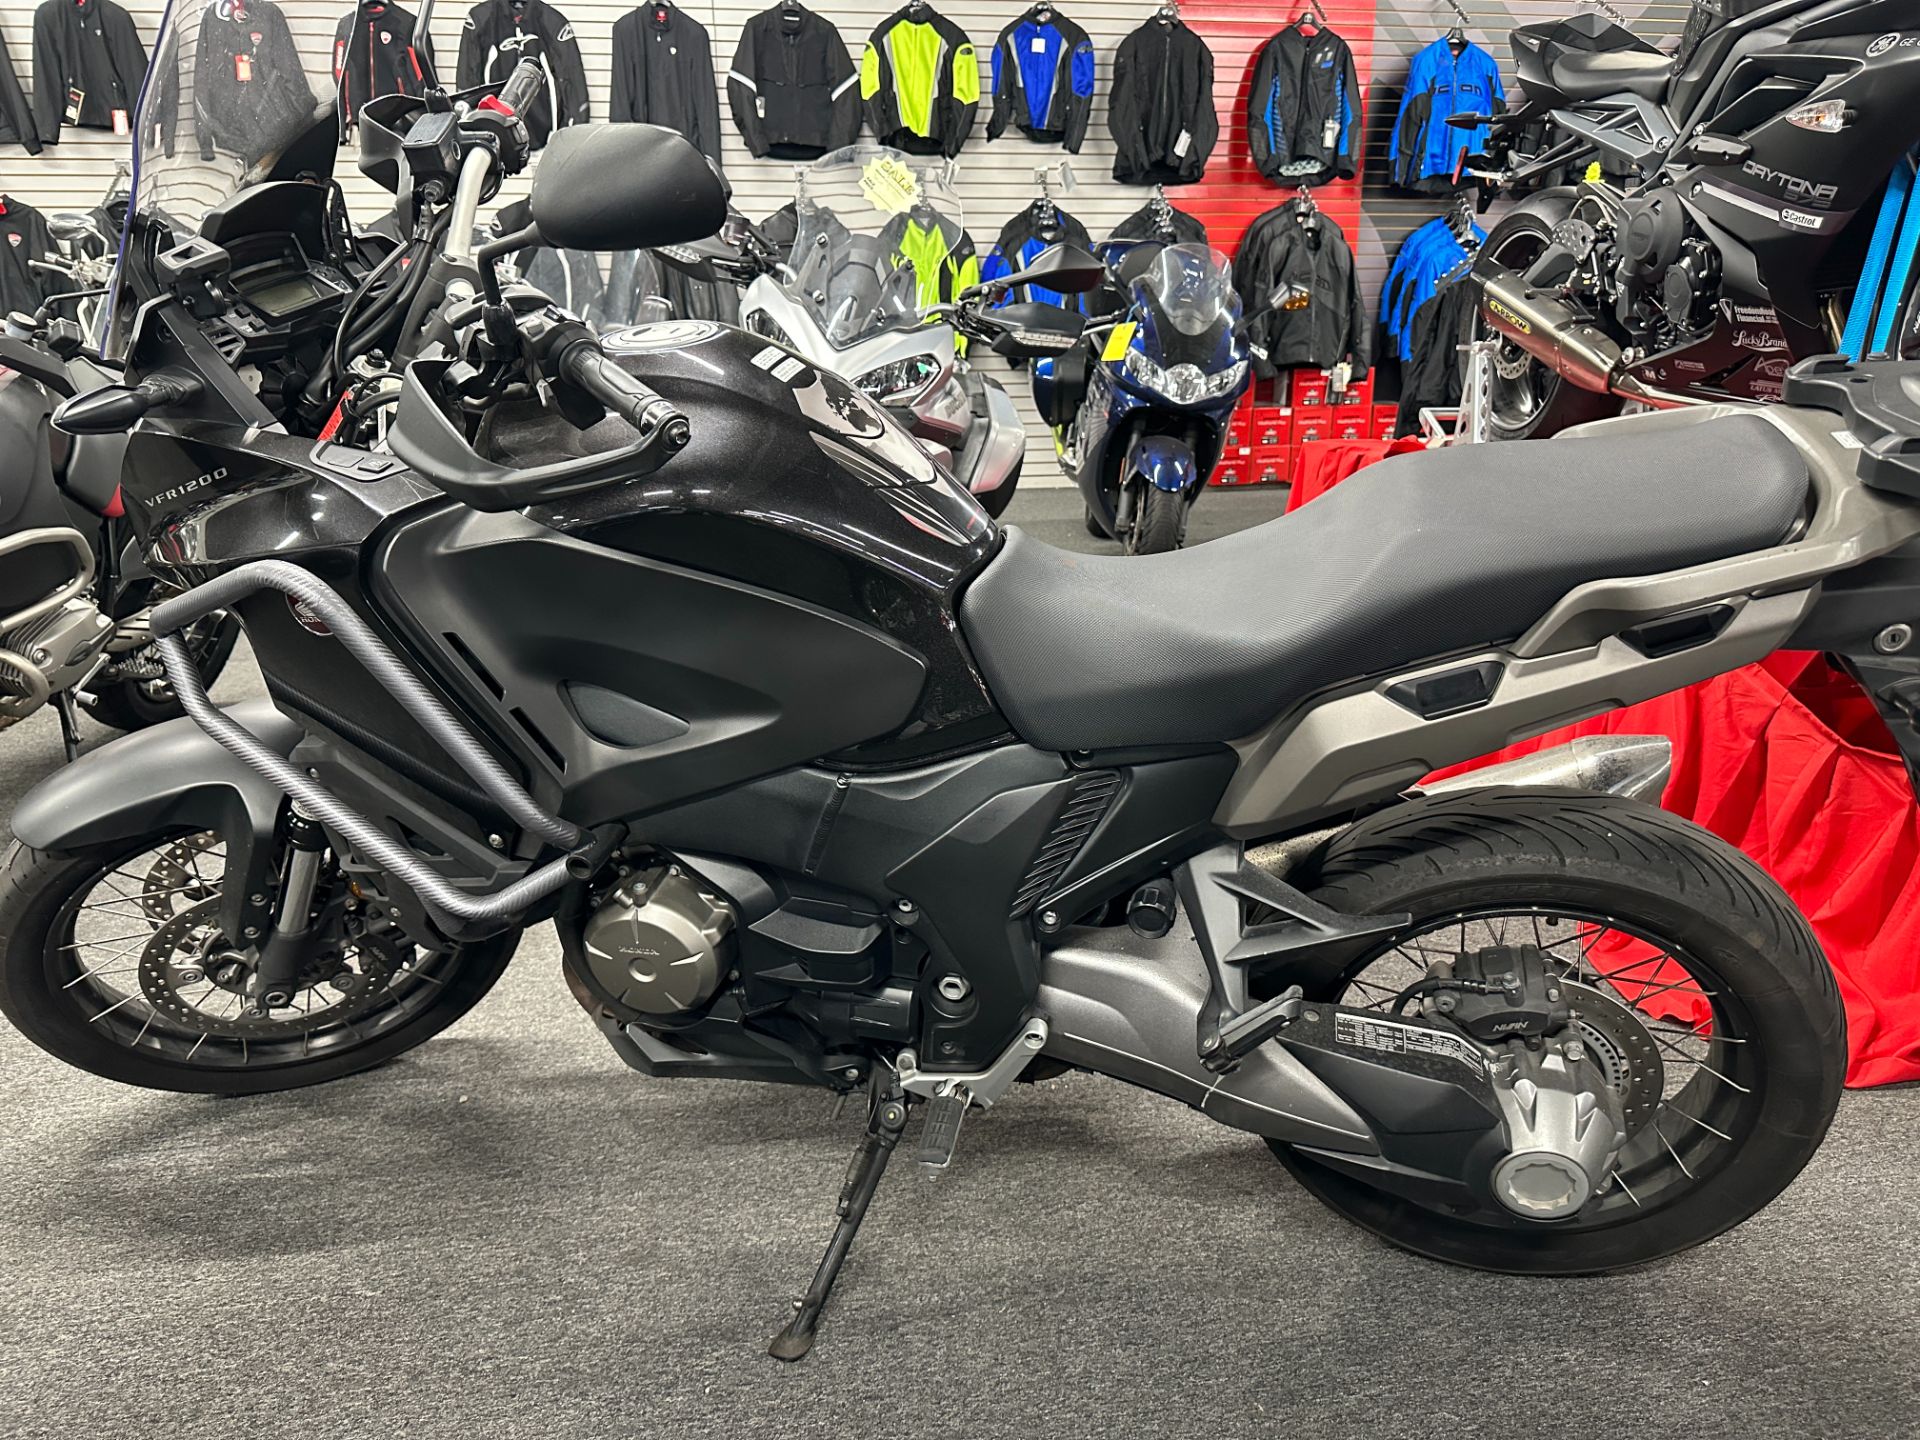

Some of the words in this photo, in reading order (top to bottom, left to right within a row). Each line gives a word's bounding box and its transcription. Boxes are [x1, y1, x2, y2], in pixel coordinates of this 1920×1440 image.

[1742, 160, 1838, 199] DAYTONA
[1789, 212, 1816, 227] Castrol
[1731, 330, 1761, 348] Lucky
[144, 467, 228, 508] VFR1200
